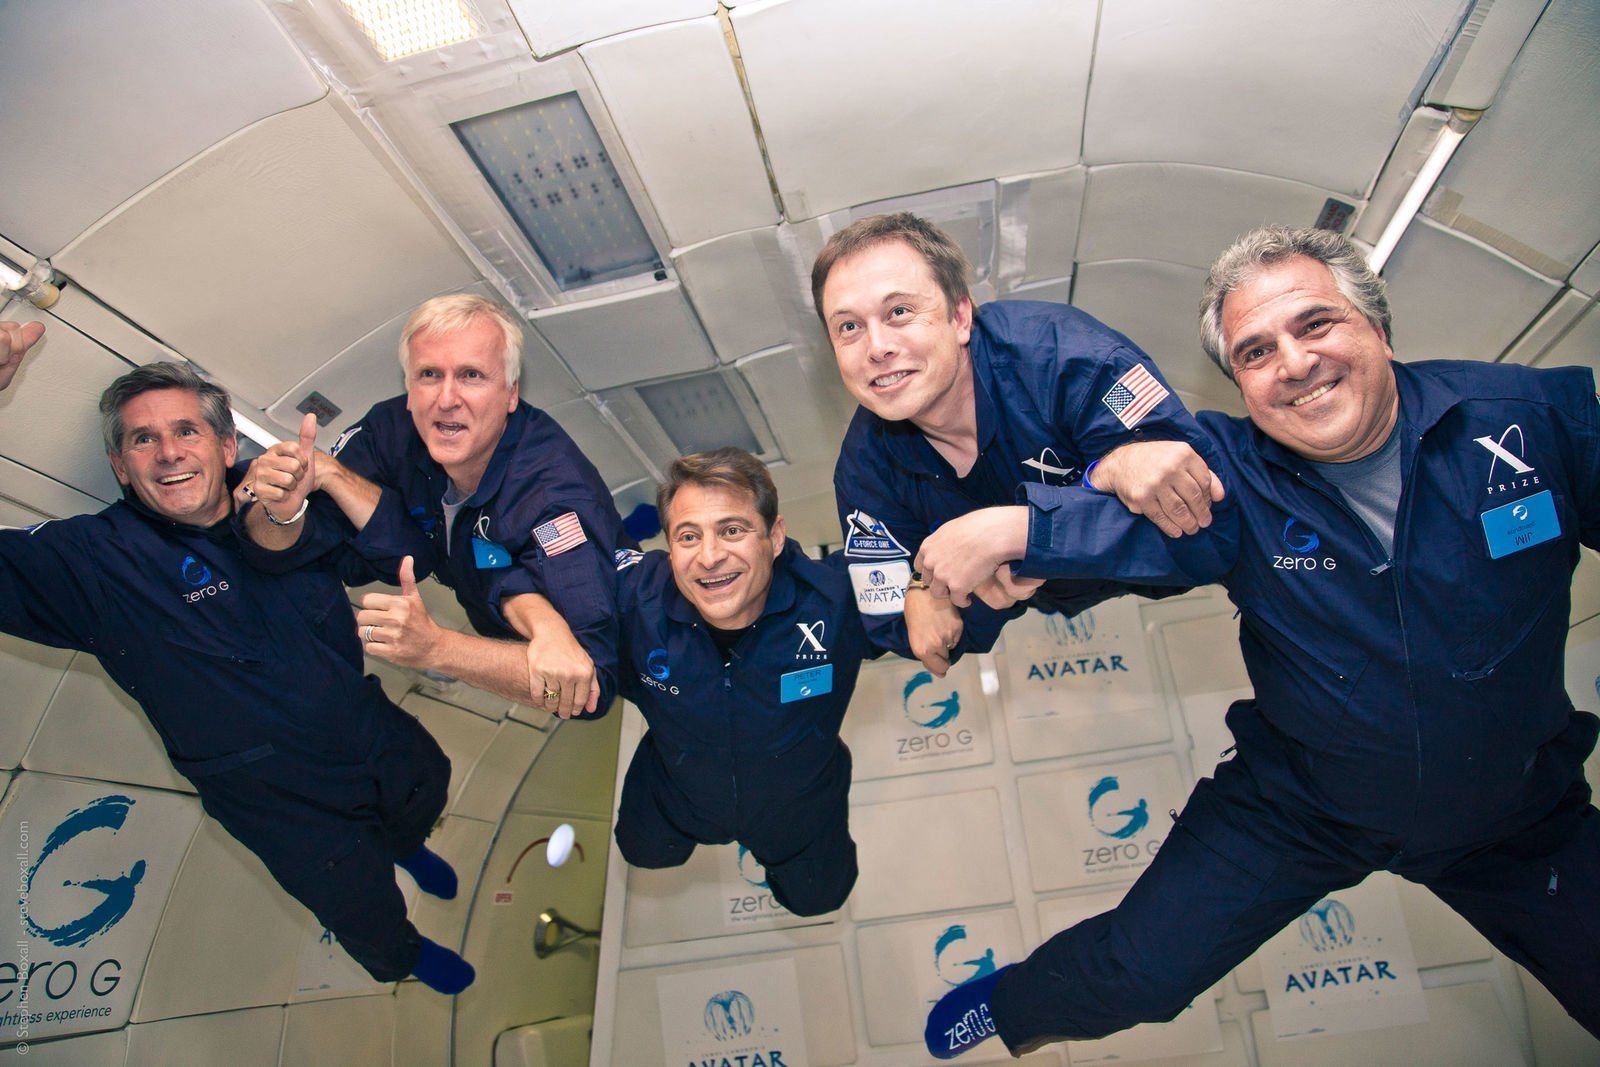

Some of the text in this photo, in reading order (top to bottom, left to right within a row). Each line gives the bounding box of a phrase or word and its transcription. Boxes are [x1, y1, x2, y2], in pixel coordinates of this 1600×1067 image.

[1487, 476, 1540, 495] PRIZE
[1273, 555, 1337, 571] zero G
[182, 580, 229, 603] zero G
[1026, 655, 1129, 680] AVATAR
[640, 672, 680, 695] zero G
[897, 732, 951, 755] zero
[956, 729, 973, 745] G
[1082, 840, 1162, 866] zero G
[90, 958, 122, 997] G
[1285, 960, 1397, 993] AVATAR
[46, 1005, 112, 1025] experience
